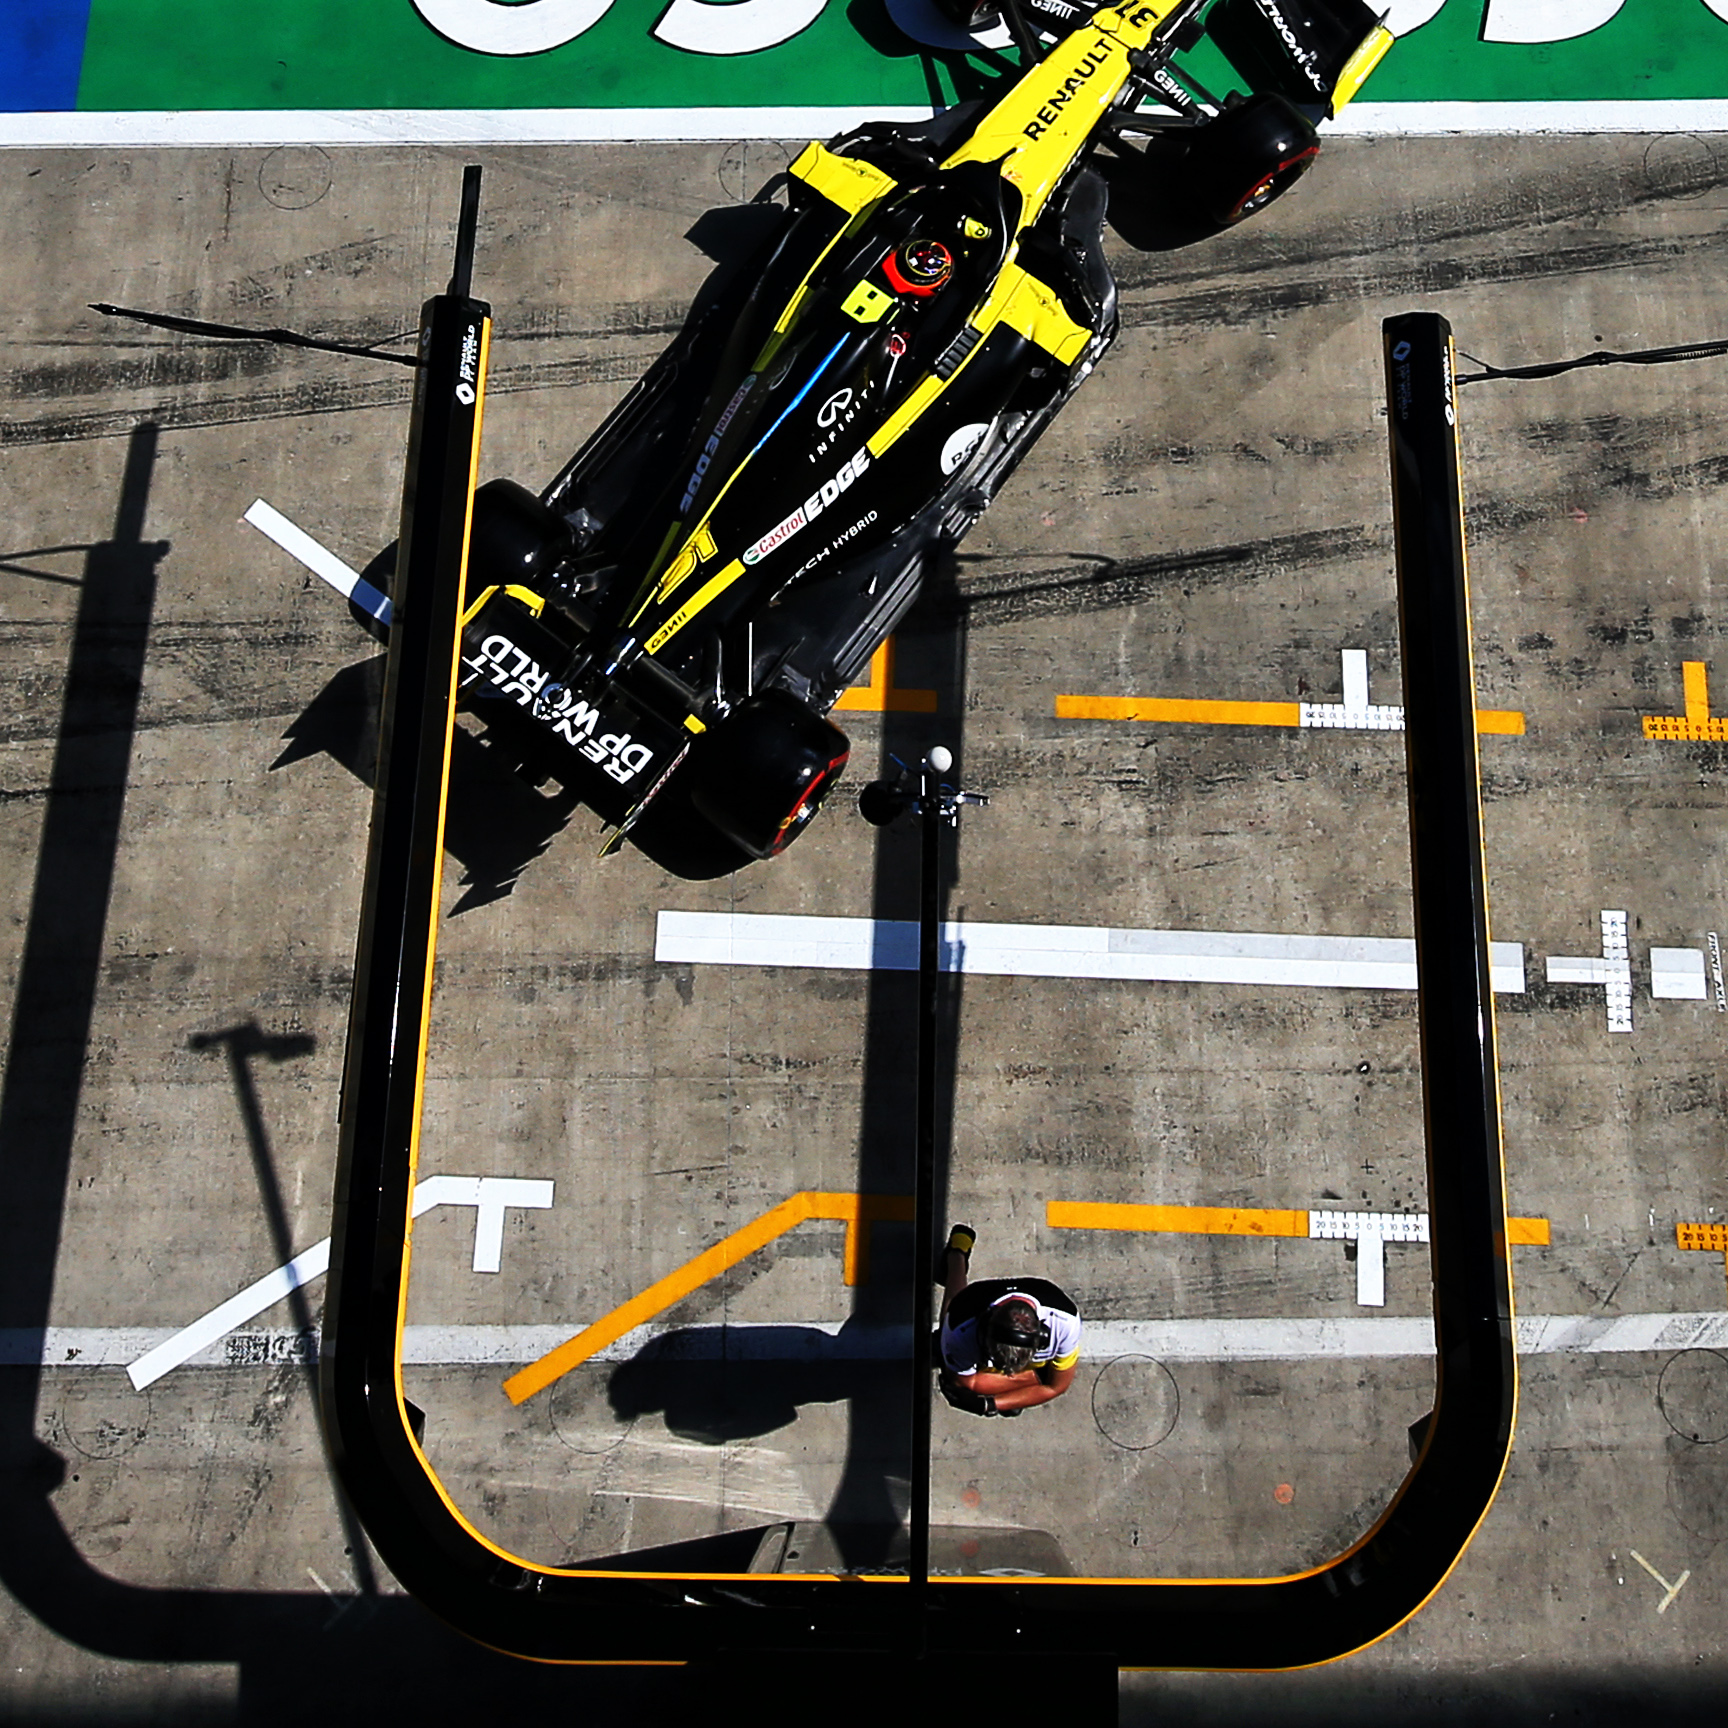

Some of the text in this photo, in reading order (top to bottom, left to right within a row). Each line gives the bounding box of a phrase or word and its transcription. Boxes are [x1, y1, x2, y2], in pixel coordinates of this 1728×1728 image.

[1022, 38, 1114, 142] RENAULT
[808, 380, 875, 463] INFINITI
[679, 434, 721, 514] EDGE
[758, 446, 872, 555] Castrol EDGE
[832, 510, 879, 550] HYBRID
[461, 653, 635, 785] RENAULT
[480, 634, 654, 774] DP WORLD
[1714, 980, 1727, 1011] AXLE
[1315, 1220, 1423, 1232] 20 15 10 5 0 5 10 15 20
[1683, 1232, 1694, 1241] 20
[1697, 1233, 1705, 1241] 15
[1709, 1233, 1718, 1242] 10
[1722, 1234, 1728, 1242] 5
